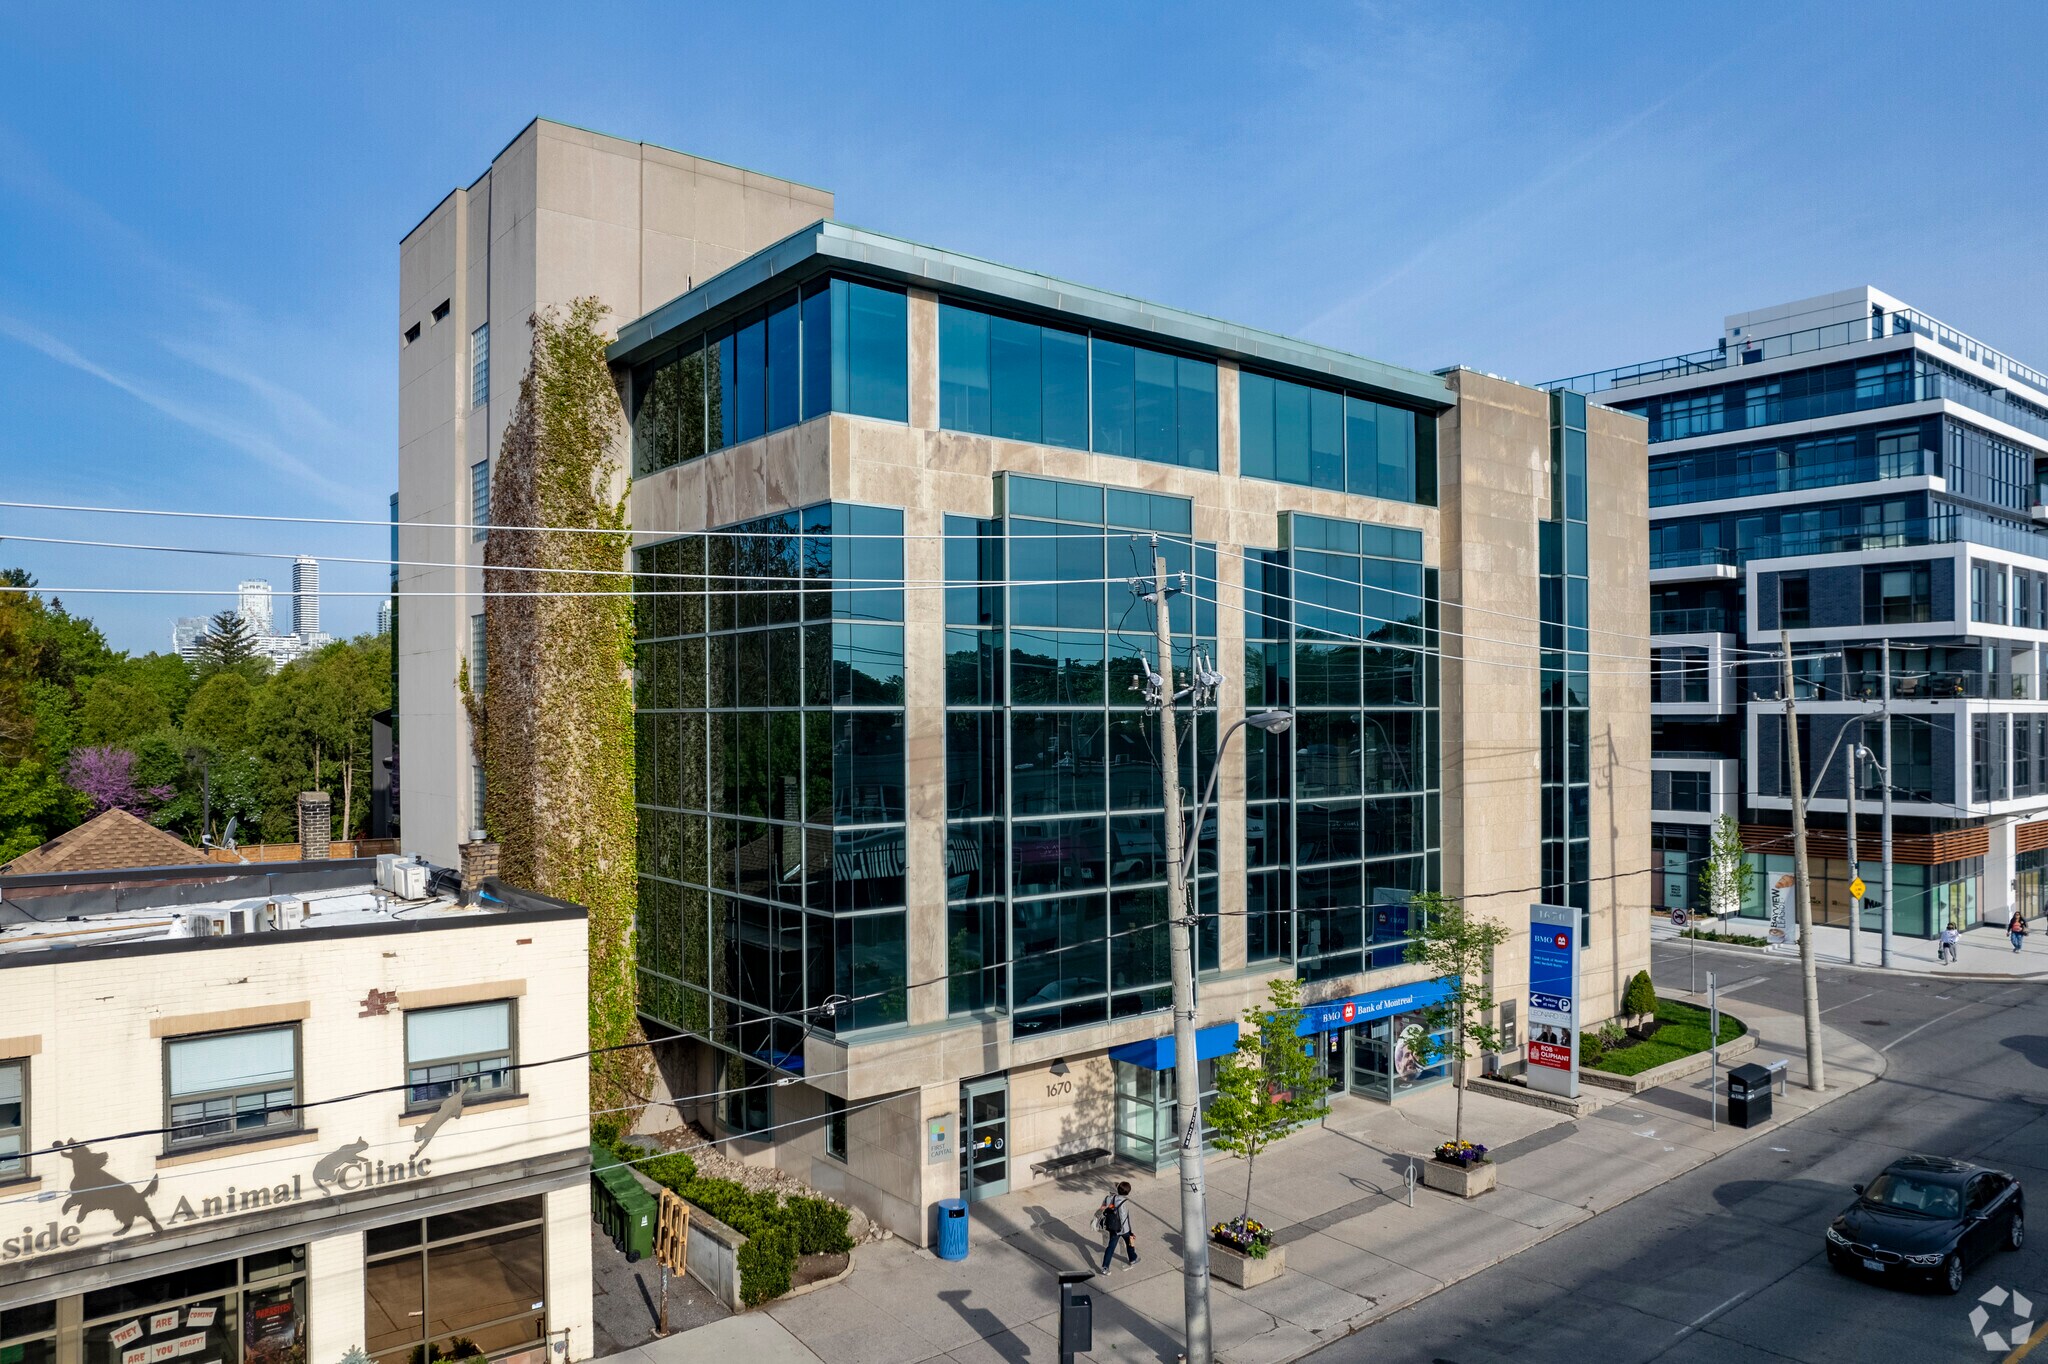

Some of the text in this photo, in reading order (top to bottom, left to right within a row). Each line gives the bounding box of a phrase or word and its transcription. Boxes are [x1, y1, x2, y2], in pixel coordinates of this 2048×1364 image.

[1539, 910, 1565, 920] 1670
[1771, 888, 1780, 927] BAYVIEW
[1534, 935, 1553, 944] BMO
[1322, 994, 1413, 1022] BMO Bank of Montreal
[1540, 1045, 1553, 1053] ROB
[1540, 1051, 1570, 1062] OLIPHANT
[1046, 1080, 1072, 1098] 1670
[930, 1147, 953, 1158] CAPITAL
[167, 1174, 302, 1225] Animal
[337, 1157, 432, 1191] Clinic
[114, 1311, 214, 1343] THEY ARE COMING
[128, 1336, 204, 1364] ARE YOU READY?
